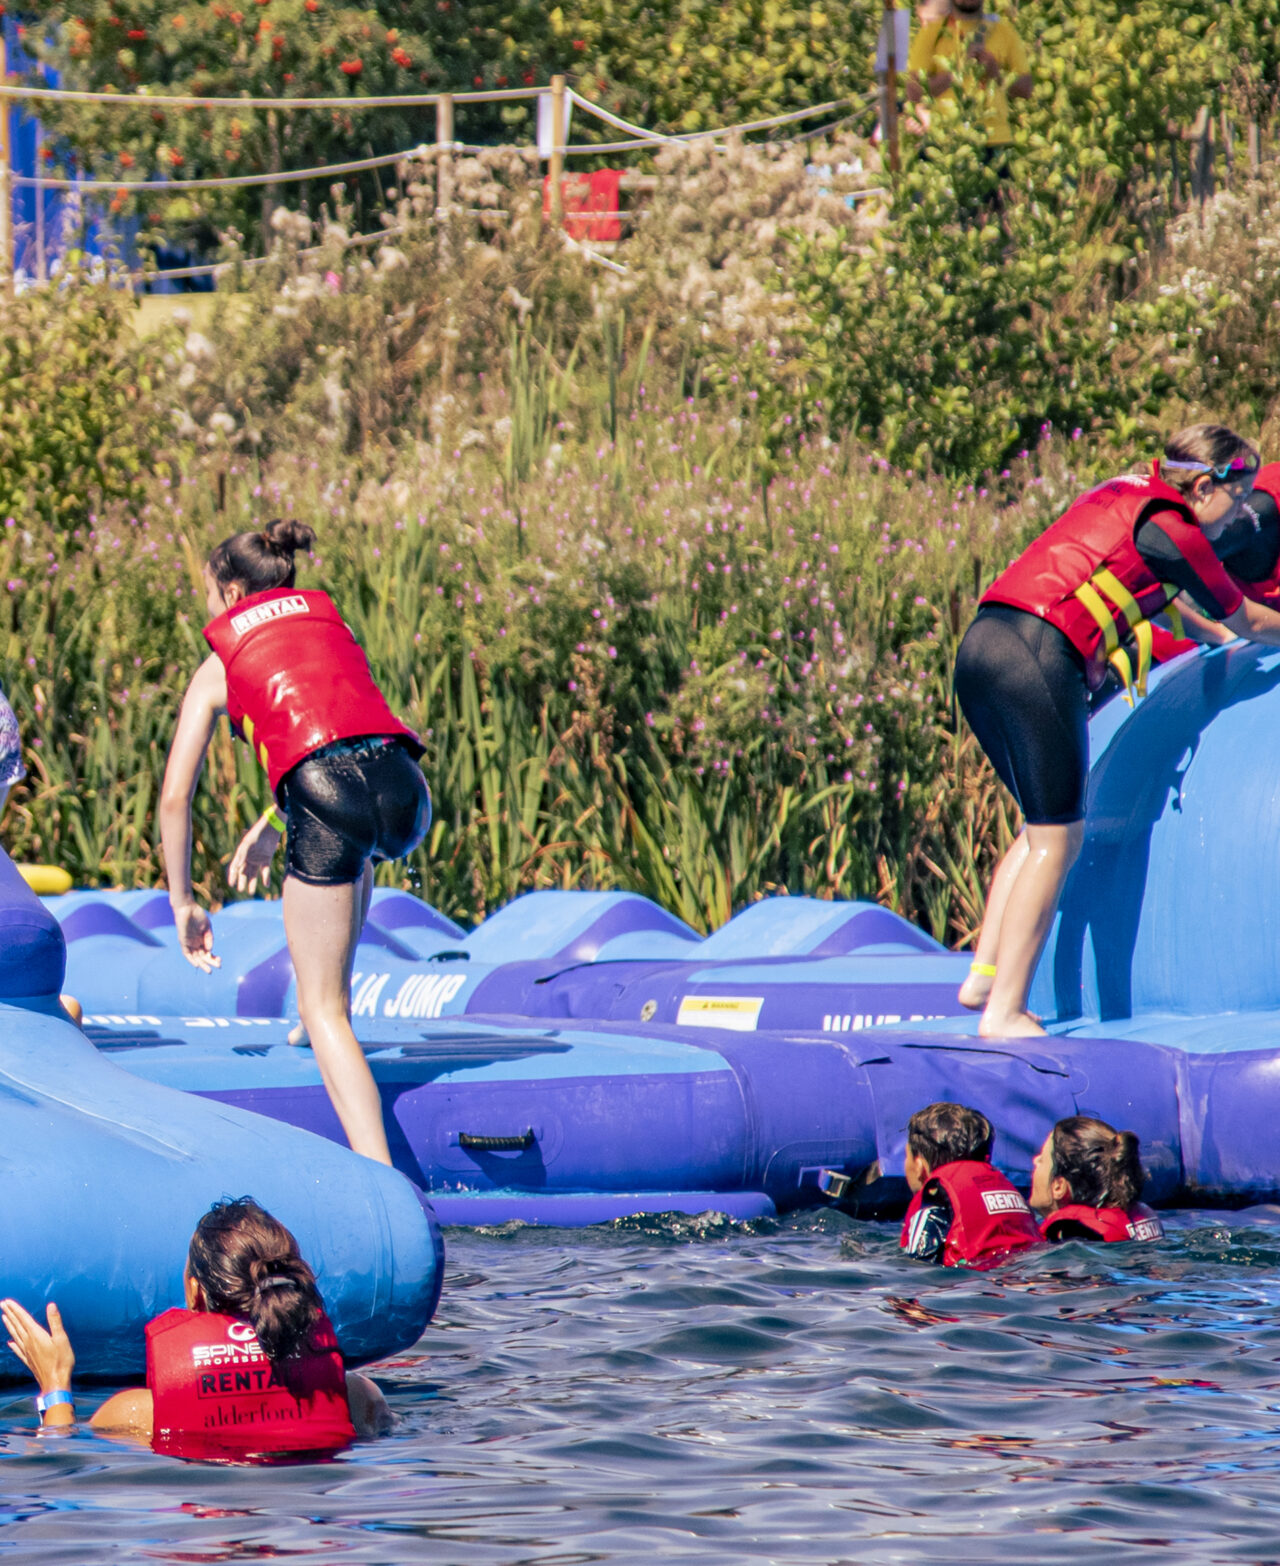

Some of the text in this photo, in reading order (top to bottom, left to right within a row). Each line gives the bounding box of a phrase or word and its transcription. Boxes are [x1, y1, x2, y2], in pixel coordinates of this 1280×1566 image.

[234, 598, 304, 632] RENTAL
[383, 974, 467, 1018] JUMP
[192, 1342, 264, 1360] SPINE
[201, 1370, 282, 1394] RENTA
[204, 1402, 302, 1428] alderford
